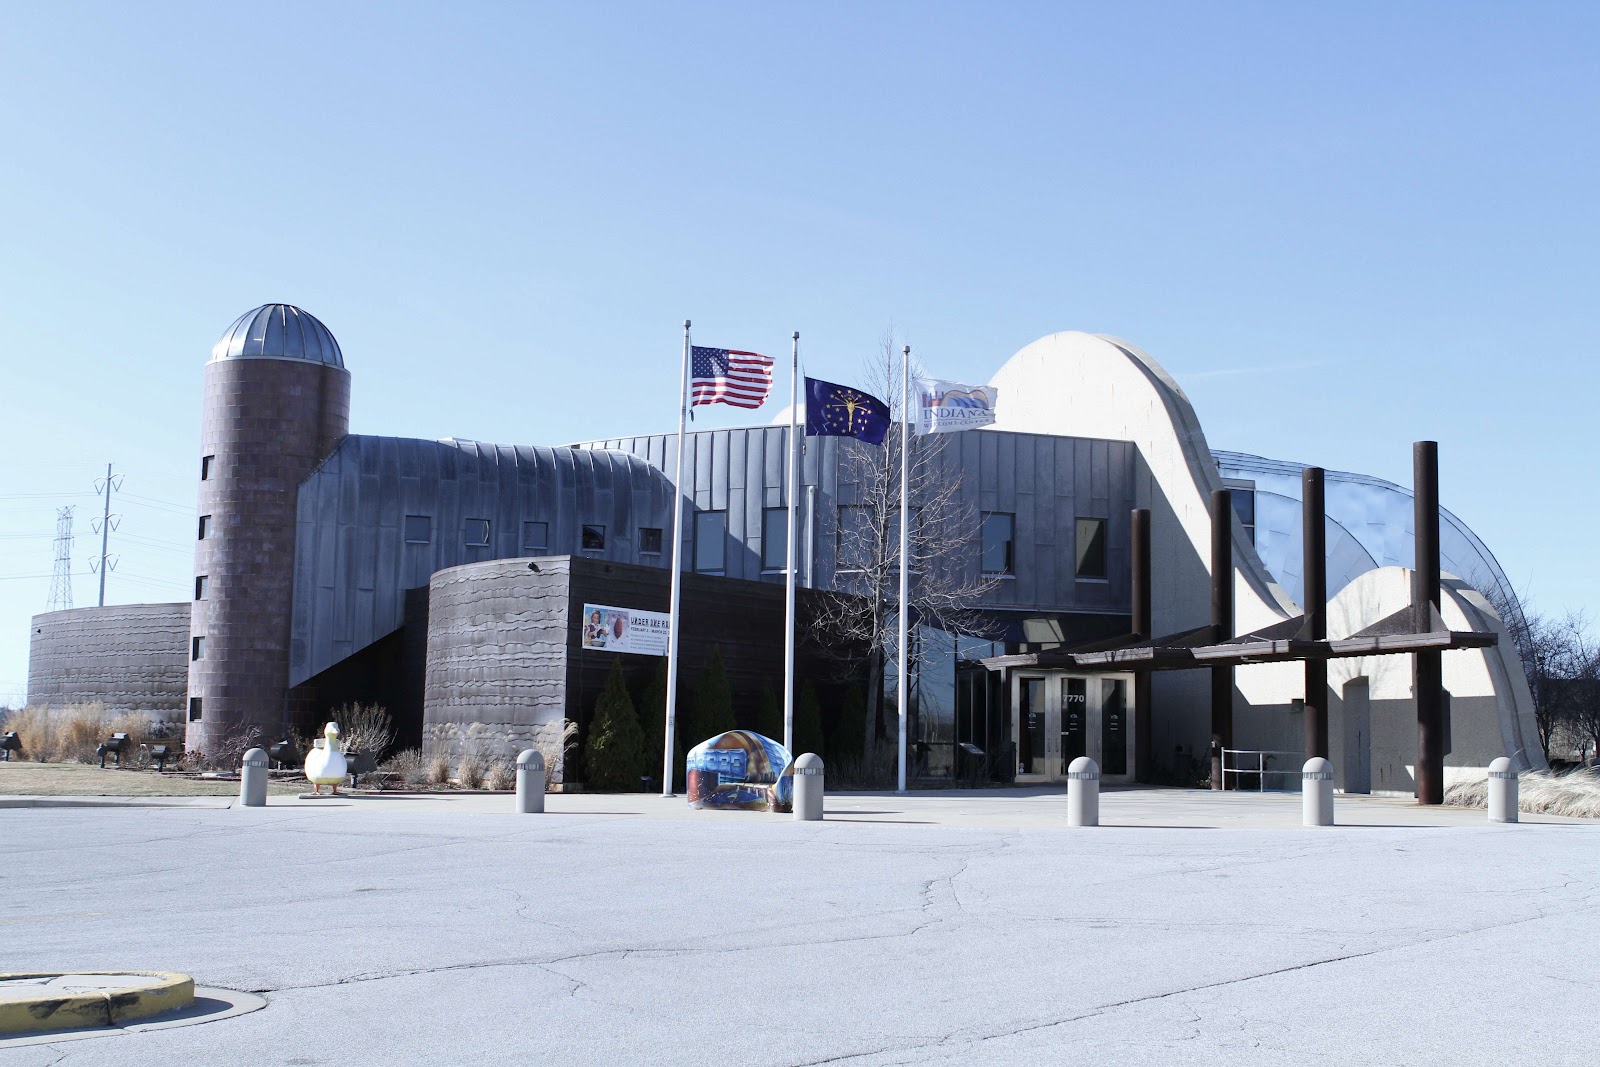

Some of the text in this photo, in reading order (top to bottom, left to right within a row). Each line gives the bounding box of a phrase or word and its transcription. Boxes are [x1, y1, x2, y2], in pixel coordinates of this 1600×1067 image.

[923, 408, 988, 419] INDIANA
[630, 616, 649, 626] UNDER
[650, 618, 661, 628] ONE
[1062, 694, 1085, 703] 7770
